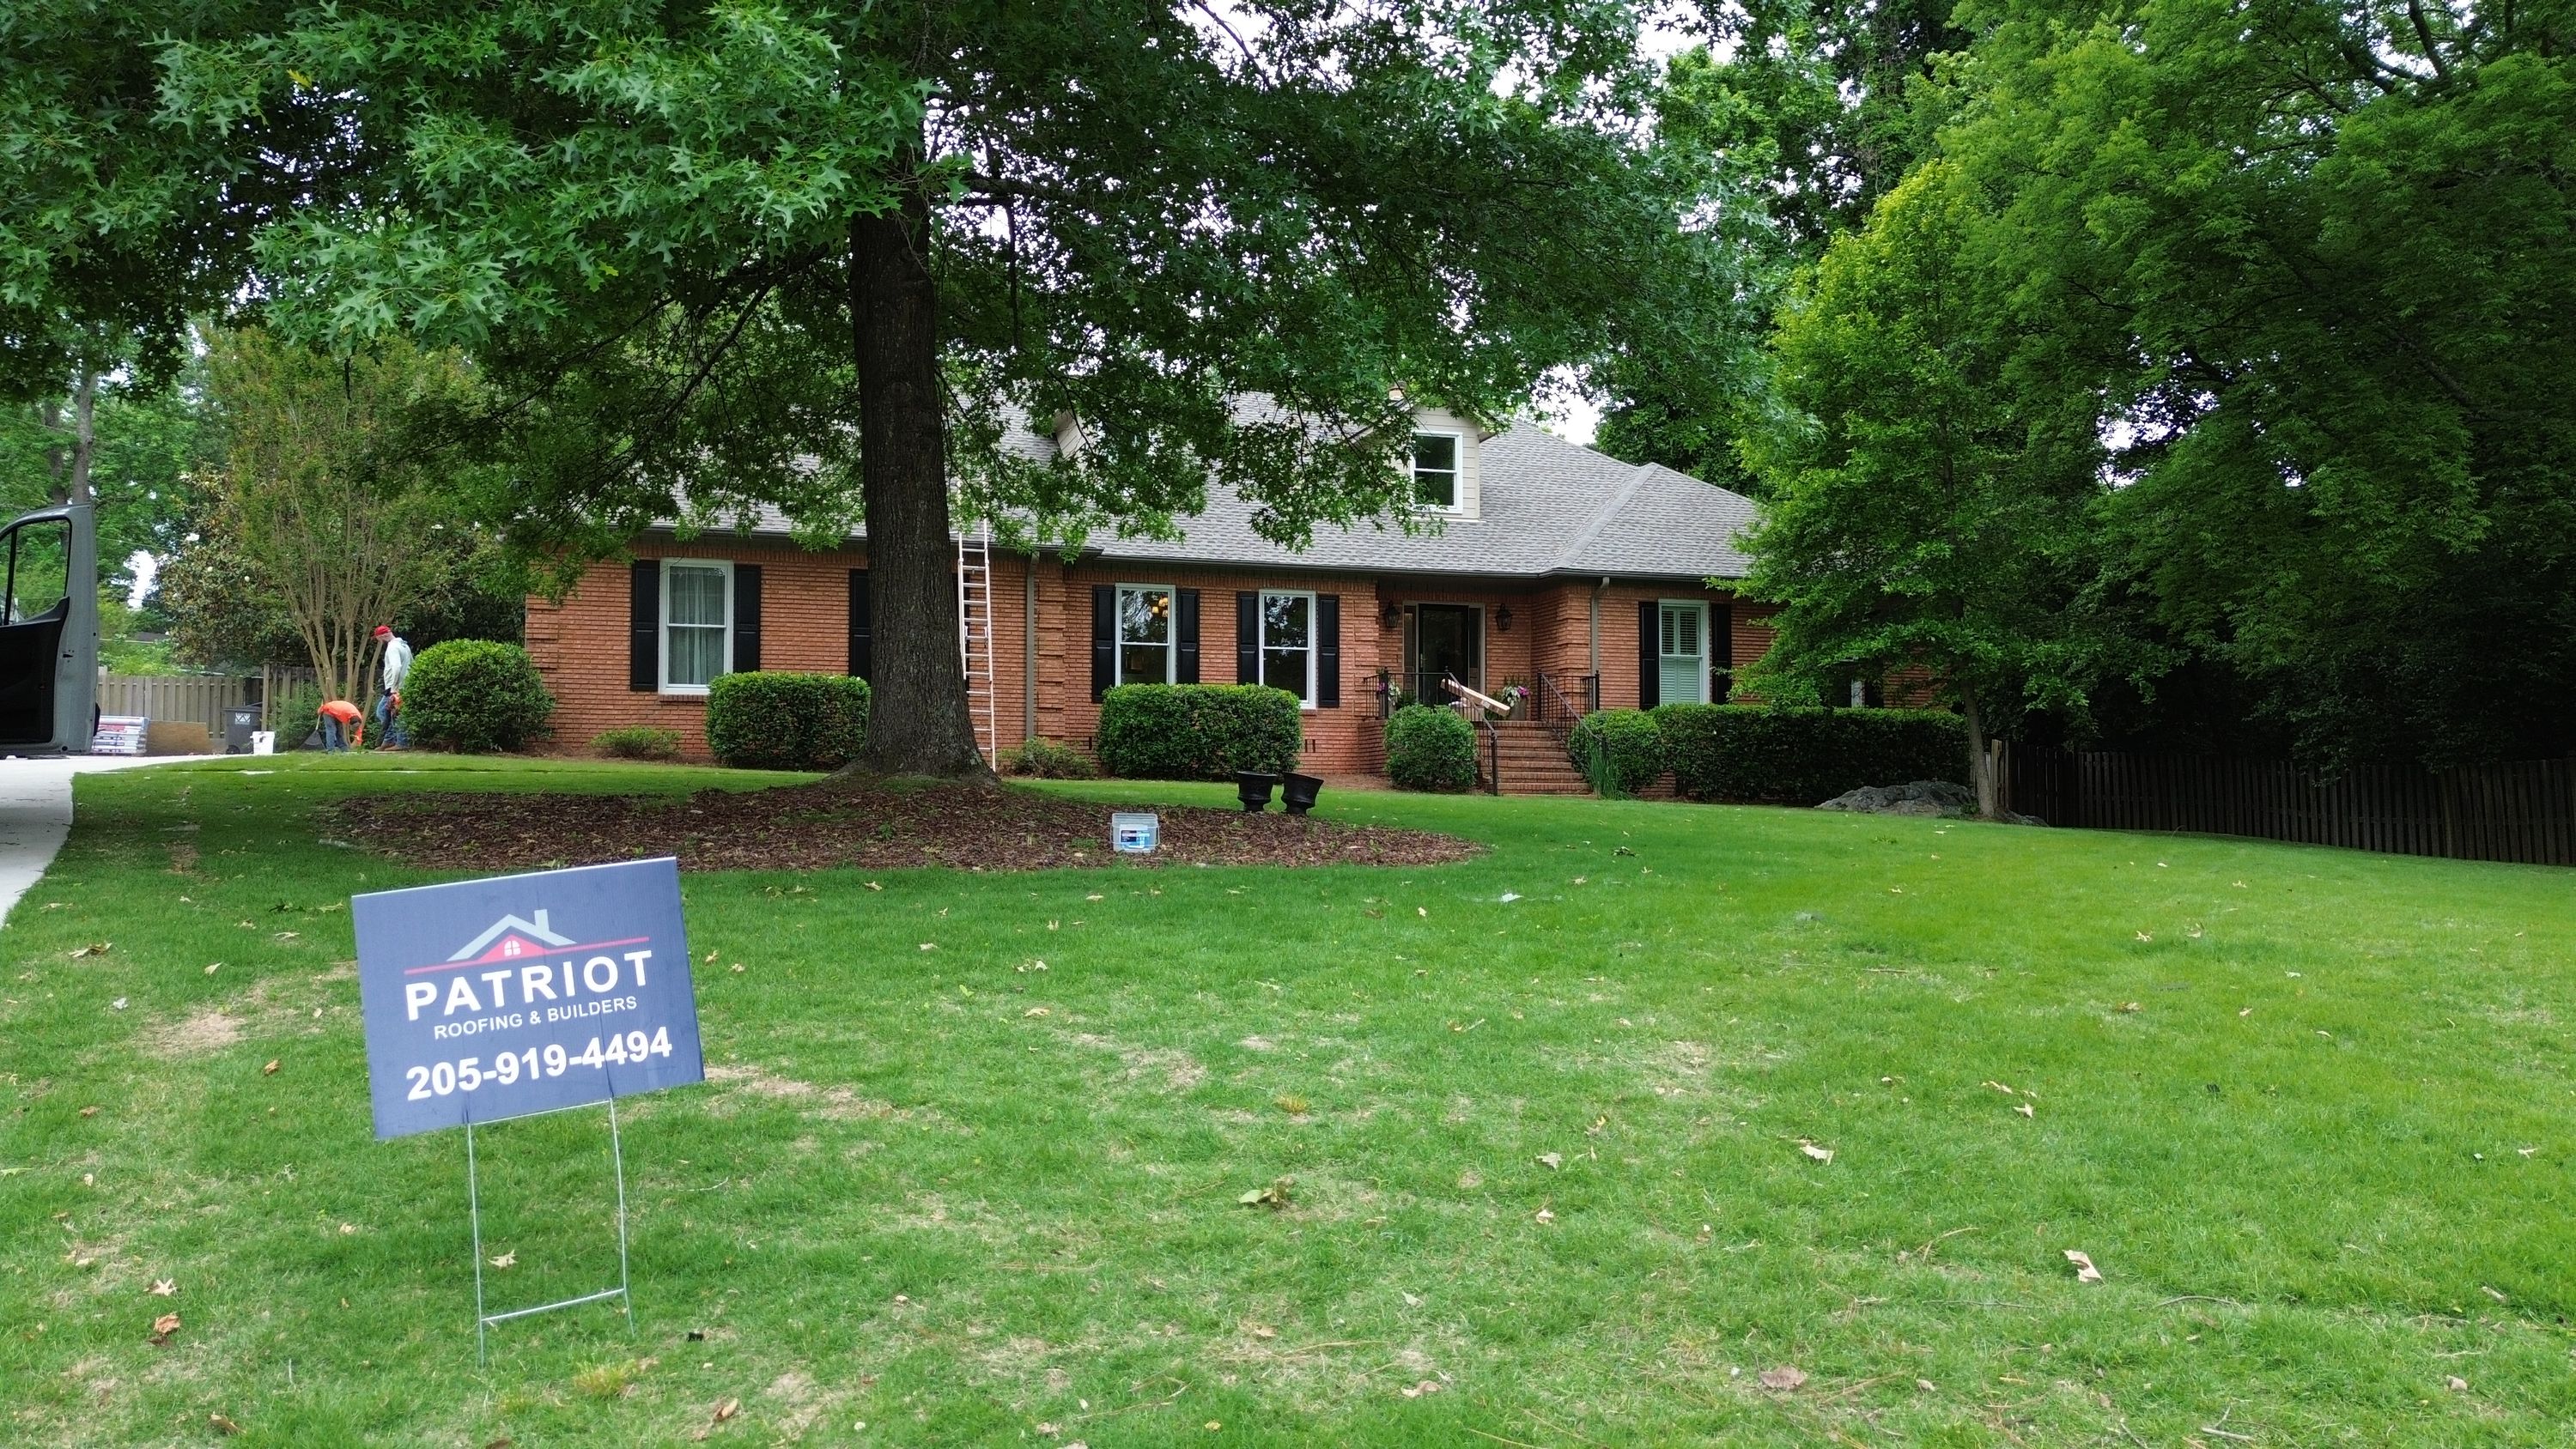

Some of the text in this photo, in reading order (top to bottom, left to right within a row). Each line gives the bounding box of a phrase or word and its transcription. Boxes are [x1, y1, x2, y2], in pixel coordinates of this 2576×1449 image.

[404, 949, 653, 1022] PATRIOT
[434, 995, 637, 1040] ROOFING & BUILDERS
[405, 1026, 673, 1101] 205-919-4494
